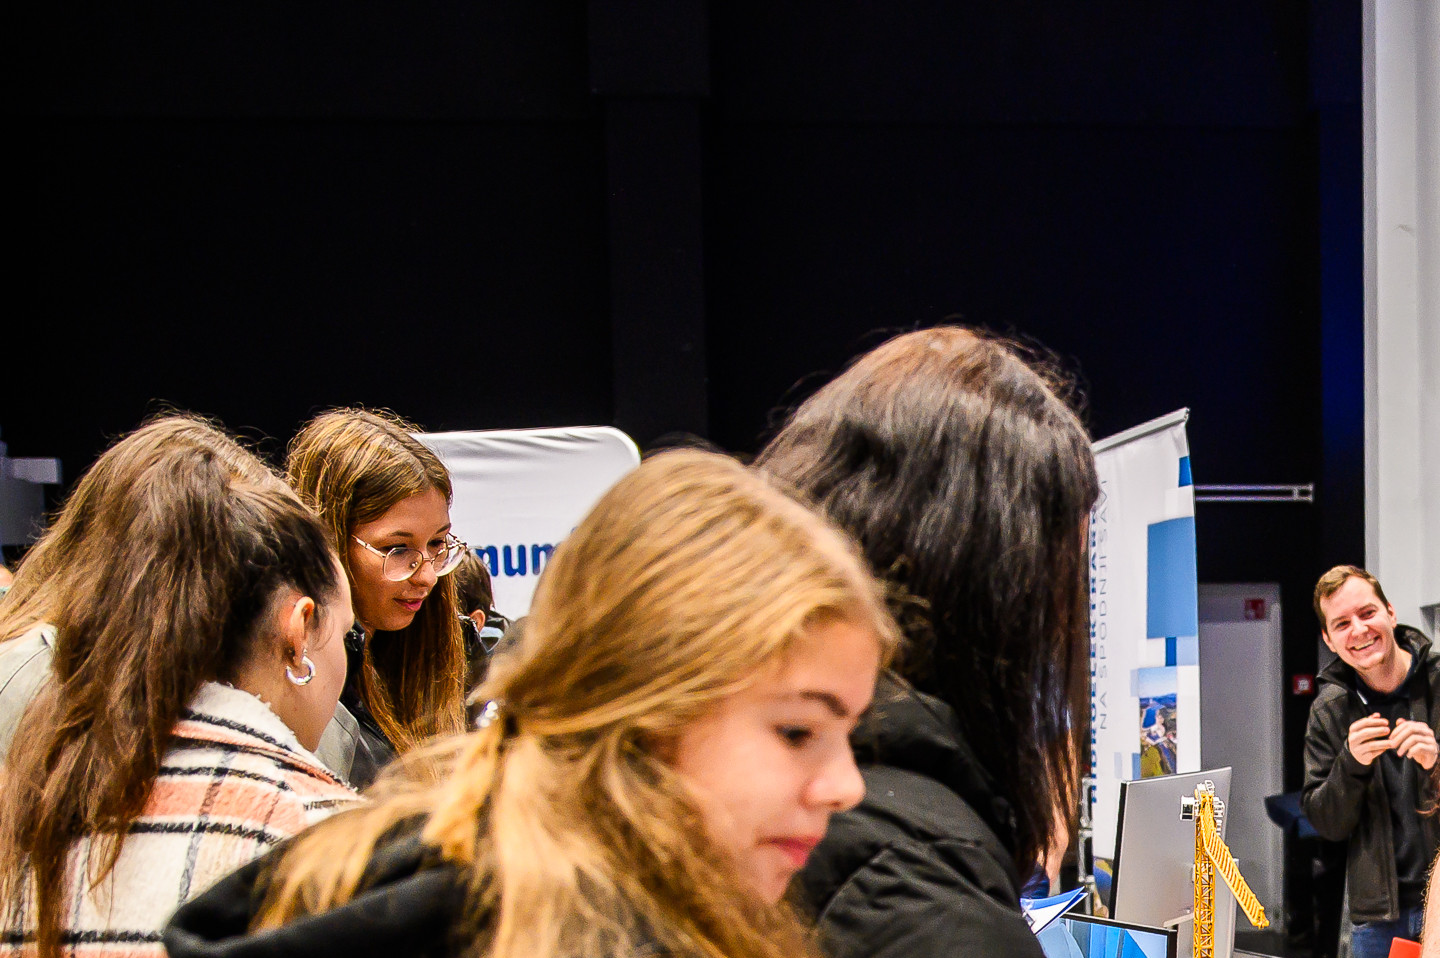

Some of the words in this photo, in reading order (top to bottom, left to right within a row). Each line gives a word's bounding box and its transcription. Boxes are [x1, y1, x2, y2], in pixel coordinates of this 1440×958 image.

[1098, 480, 1108, 542] SAVI
[1099, 555, 1107, 679] SPODNJI
[1099, 690, 1107, 730] NA
